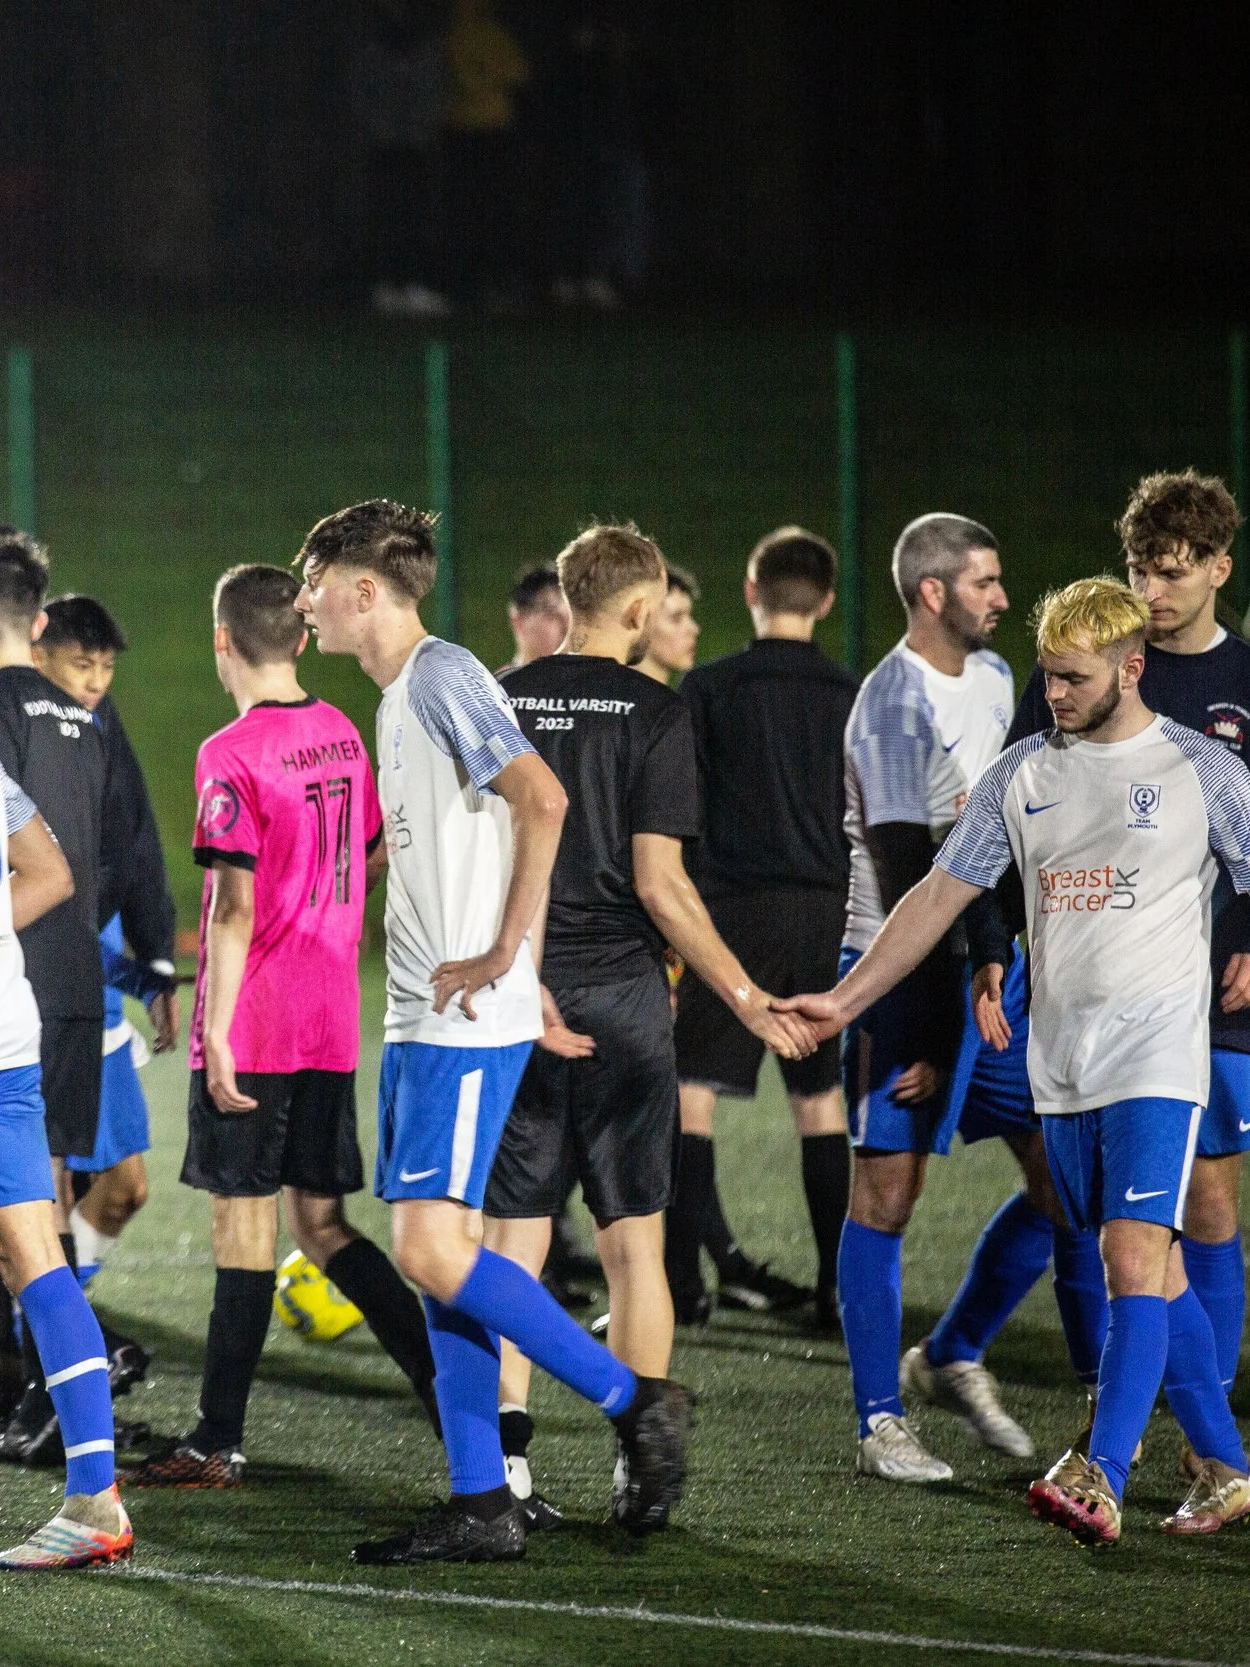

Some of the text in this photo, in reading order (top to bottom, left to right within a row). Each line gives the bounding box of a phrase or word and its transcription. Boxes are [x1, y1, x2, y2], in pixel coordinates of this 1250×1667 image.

[569, 698, 635, 715] VARSITY
[535, 717, 575, 730] 2023
[281, 740, 362, 773] HAMMER
[392, 803, 413, 849] UK
[305, 776, 352, 907] 17
[1038, 865, 1114, 892] Breast
[1111, 867, 1140, 910] UK
[1040, 893, 1113, 914] Cancer
